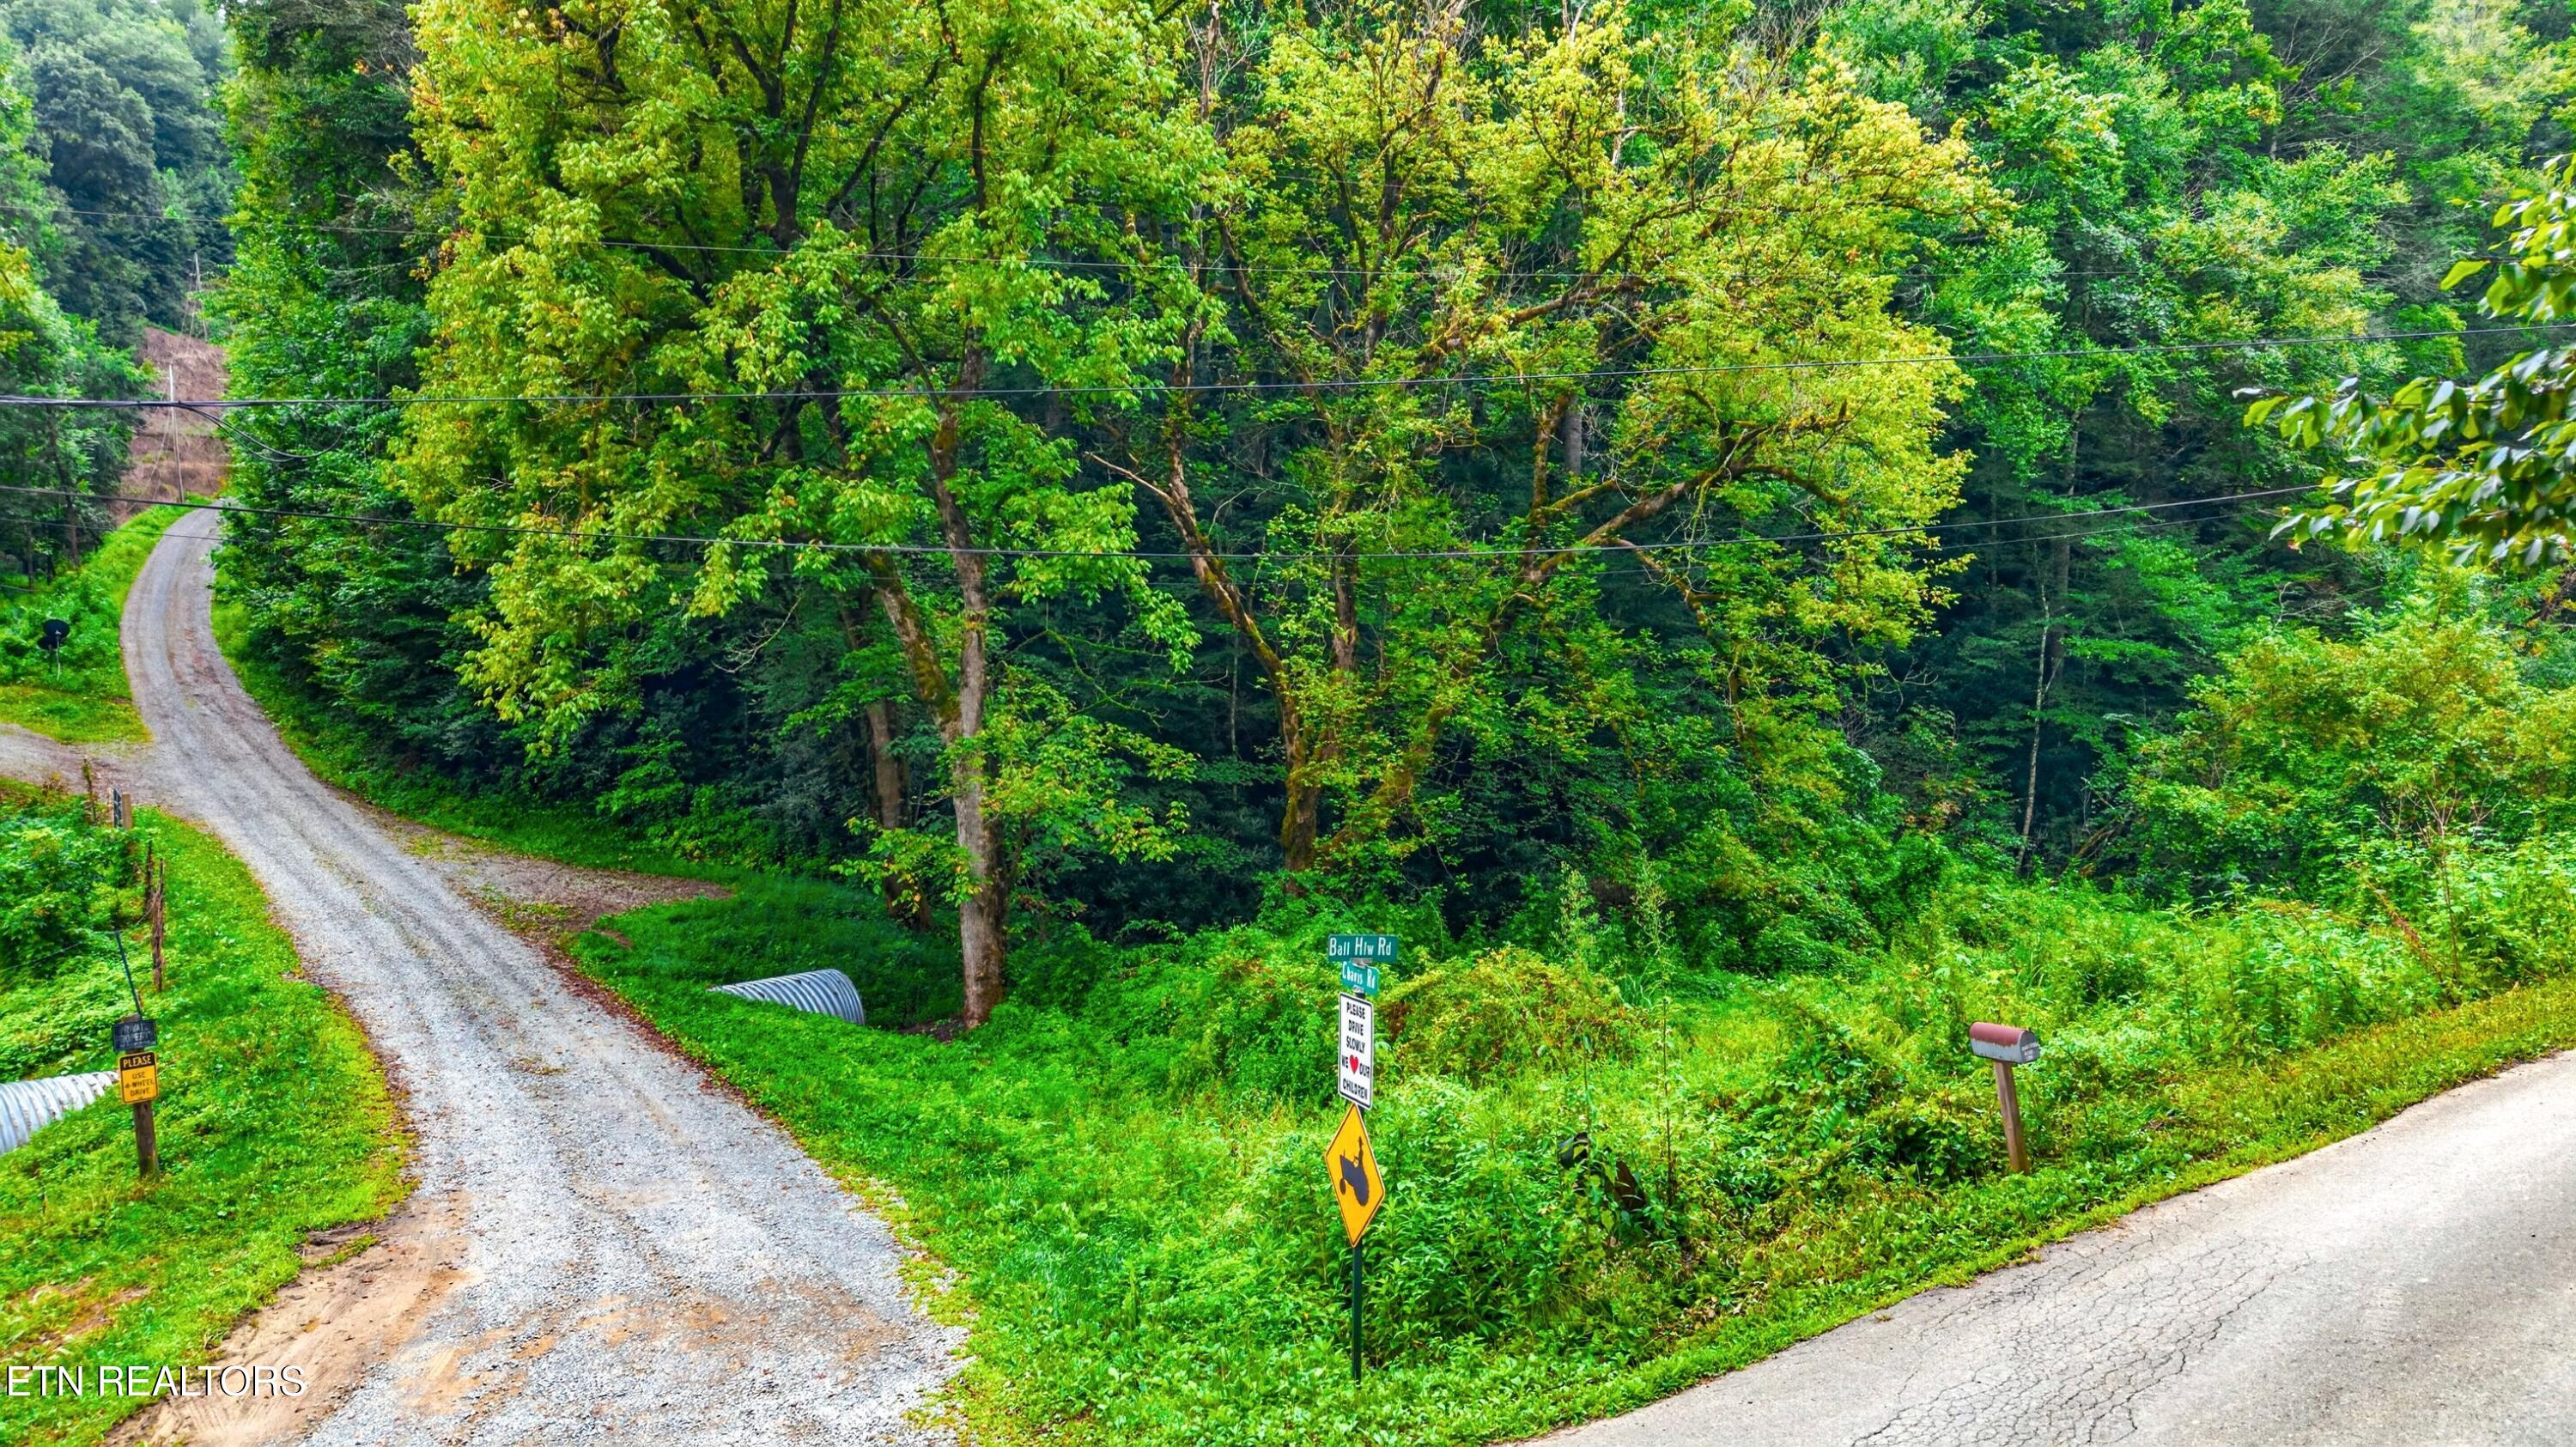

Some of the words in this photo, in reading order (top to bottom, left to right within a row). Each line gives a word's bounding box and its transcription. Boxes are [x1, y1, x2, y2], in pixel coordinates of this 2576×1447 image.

[1329, 937, 1350, 956] Ball
[1354, 937, 1374, 956] Hlw
[1377, 937, 1392, 956] Rd
[1366, 968, 1376, 988] Rd
[1346, 1001, 1365, 1019] PLEASE
[1348, 1019, 1364, 1037] DRIVE
[1346, 1036, 1365, 1055] SLOWLY
[123, 1055, 152, 1068] PLEASE
[1341, 1055, 1349, 1069] WE
[1359, 1062, 1370, 1079] OUR
[132, 1071, 145, 1079] USE
[1342, 1078, 1368, 1101] CHILDREN
